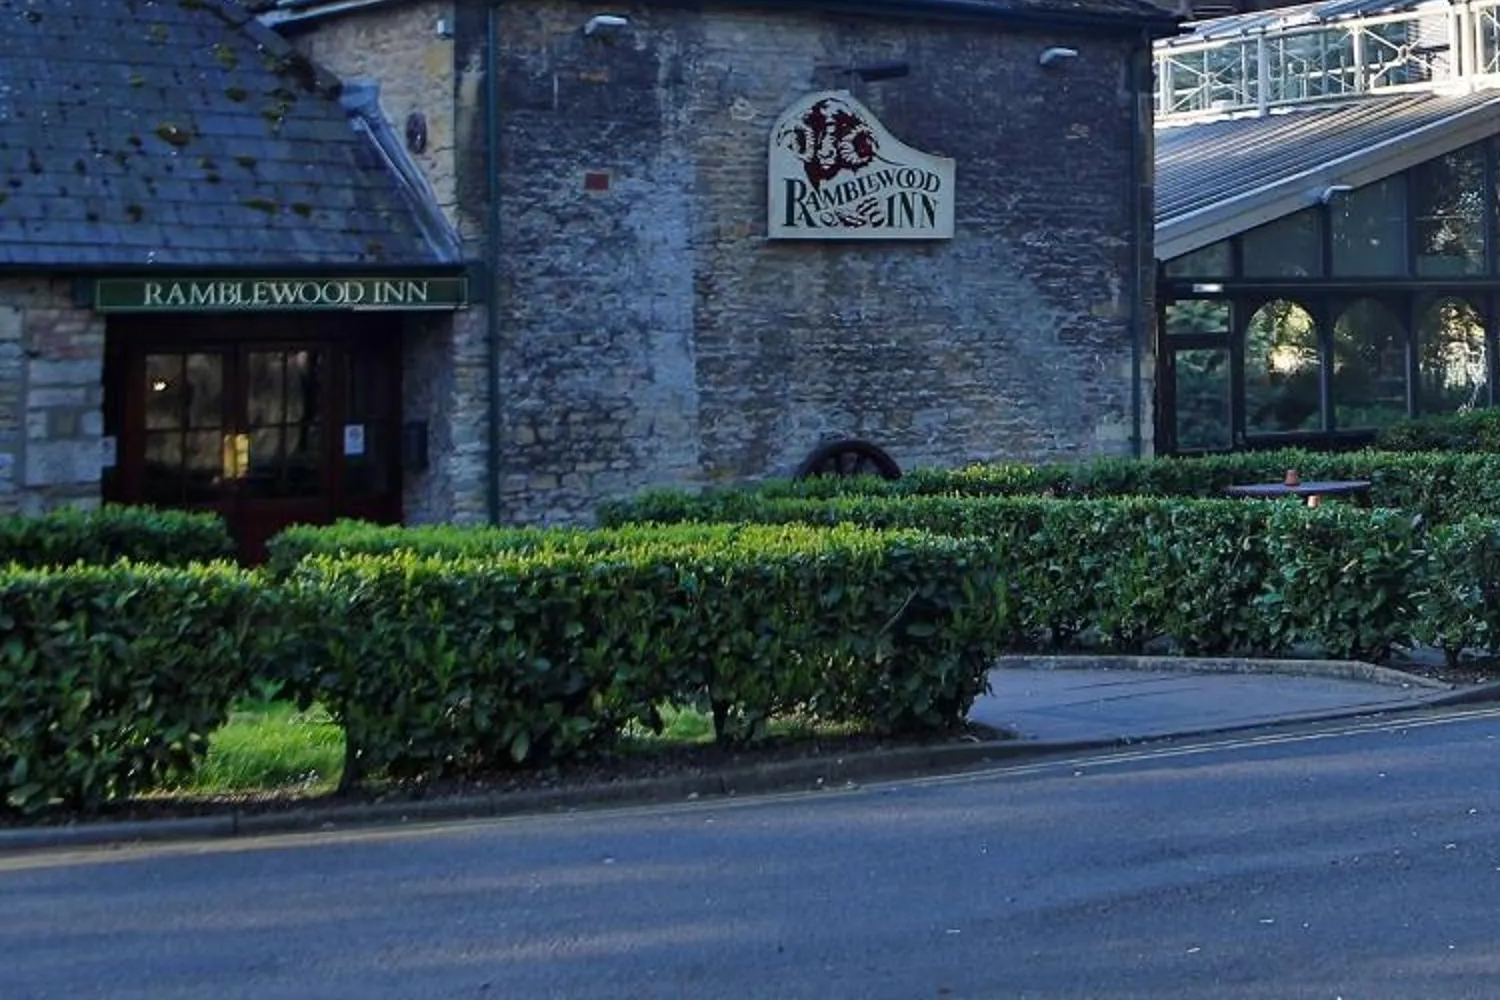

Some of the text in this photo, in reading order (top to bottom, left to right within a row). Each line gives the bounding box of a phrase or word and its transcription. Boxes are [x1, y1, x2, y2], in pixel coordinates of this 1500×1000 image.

[783, 167, 941, 229] RAMBLEWOOD
[885, 191, 940, 229] INN
[144, 281, 428, 305] RAMBLEWOOD INN
